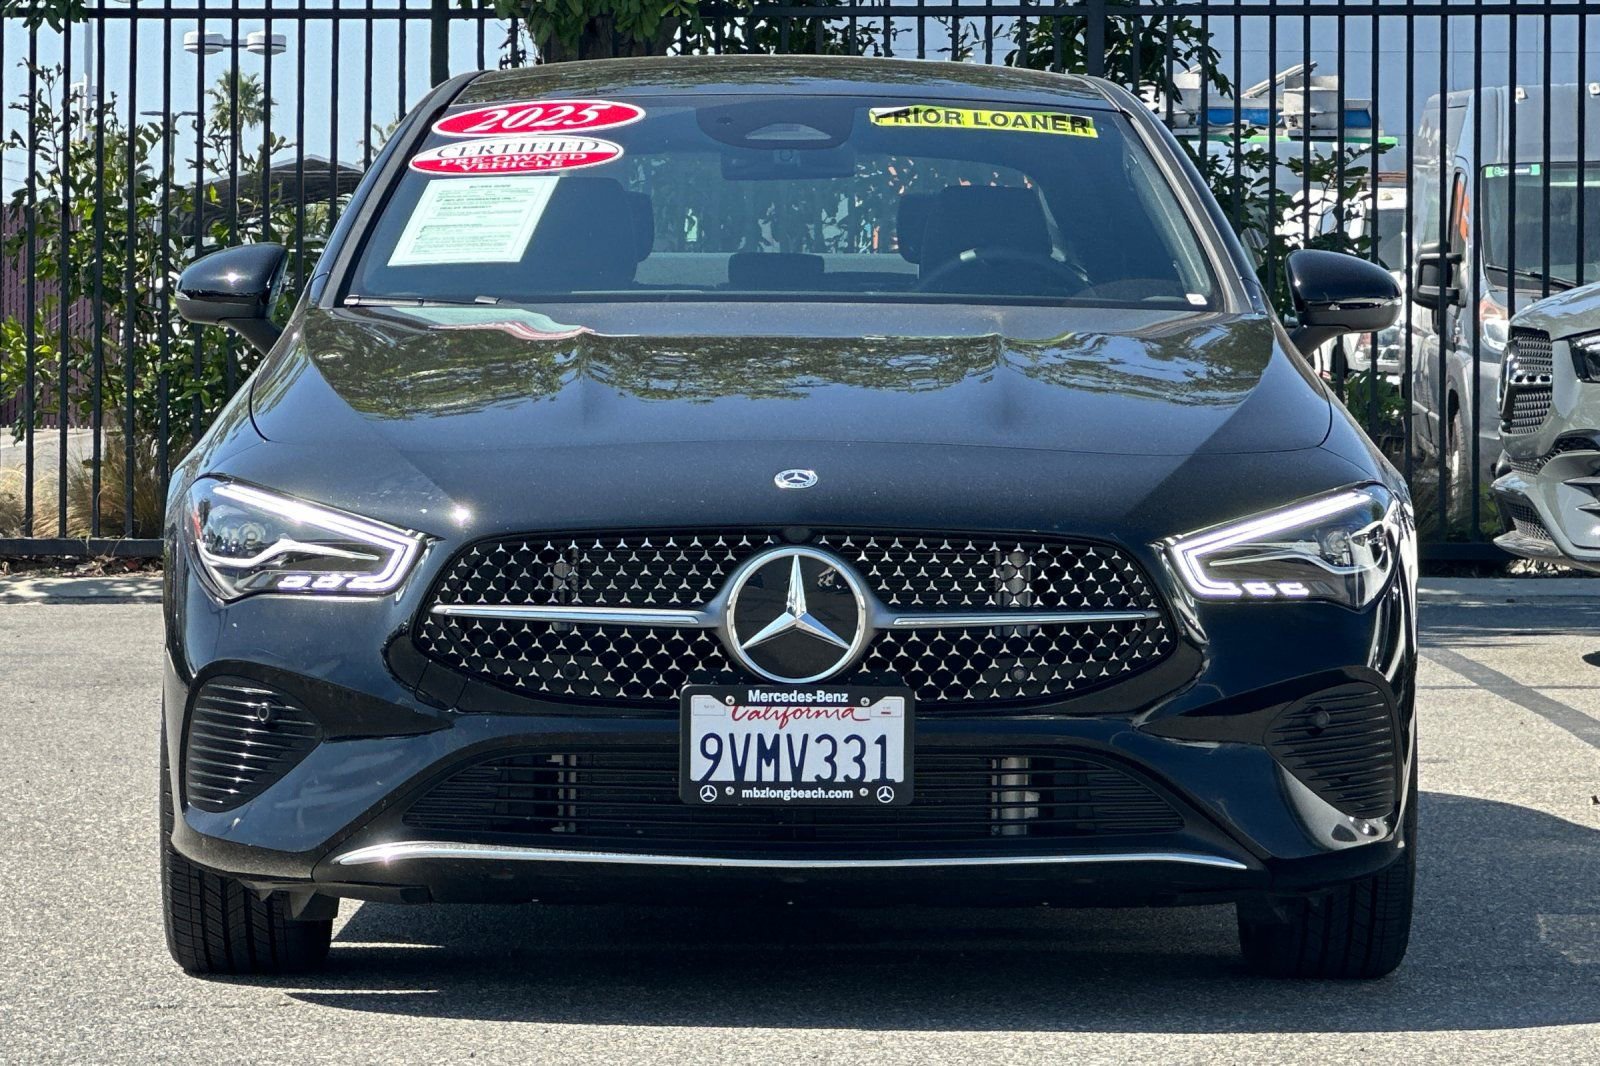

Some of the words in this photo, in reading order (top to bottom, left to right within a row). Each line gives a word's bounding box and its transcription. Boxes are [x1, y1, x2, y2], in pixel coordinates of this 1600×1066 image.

[463, 104, 612, 133] 2025
[973, 112, 1089, 133] LOANER
[437, 141, 599, 158] CERTIFIED
[439, 152, 588, 167] PRE-OWNED
[461, 161, 564, 171] VEHICLE
[748, 690, 849, 703] Mercedes-Benz
[731, 705, 871, 729] California
[699, 732, 896, 783] 9VMV331
[742, 788, 853, 801] mbzlongbeach.com
